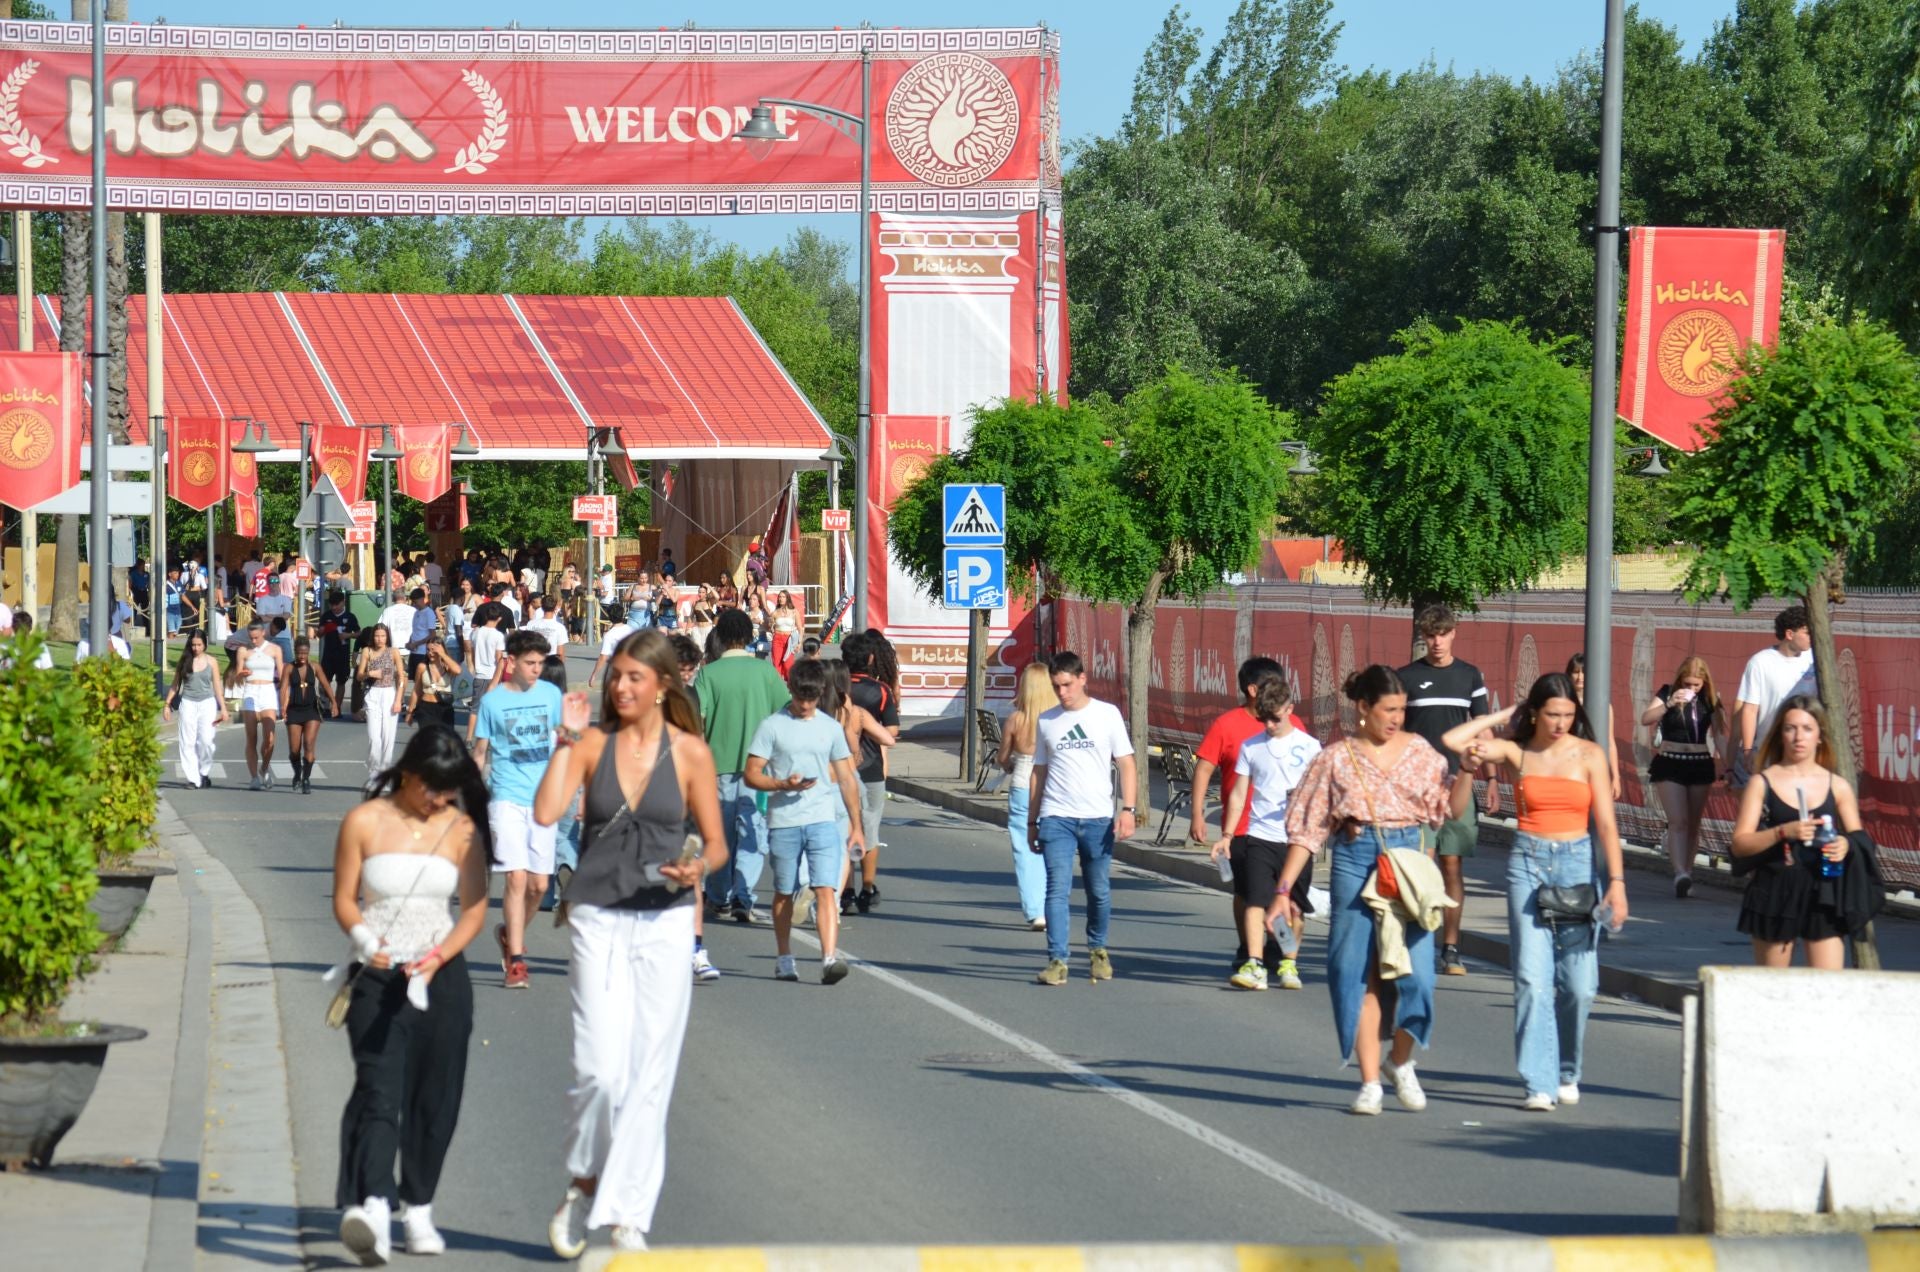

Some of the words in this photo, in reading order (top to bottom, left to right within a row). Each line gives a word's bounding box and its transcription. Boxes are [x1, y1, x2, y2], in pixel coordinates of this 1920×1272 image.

[913, 257, 985, 274] Holika
[1655, 280, 1749, 307] Holika
[0, 387, 60, 406] olika
[888, 438, 935, 452] Holika
[826, 516, 847, 526] VIP
[958, 556, 992, 600] P
[911, 647, 968, 663] Holik
[1056, 740, 1096, 751] adidas
